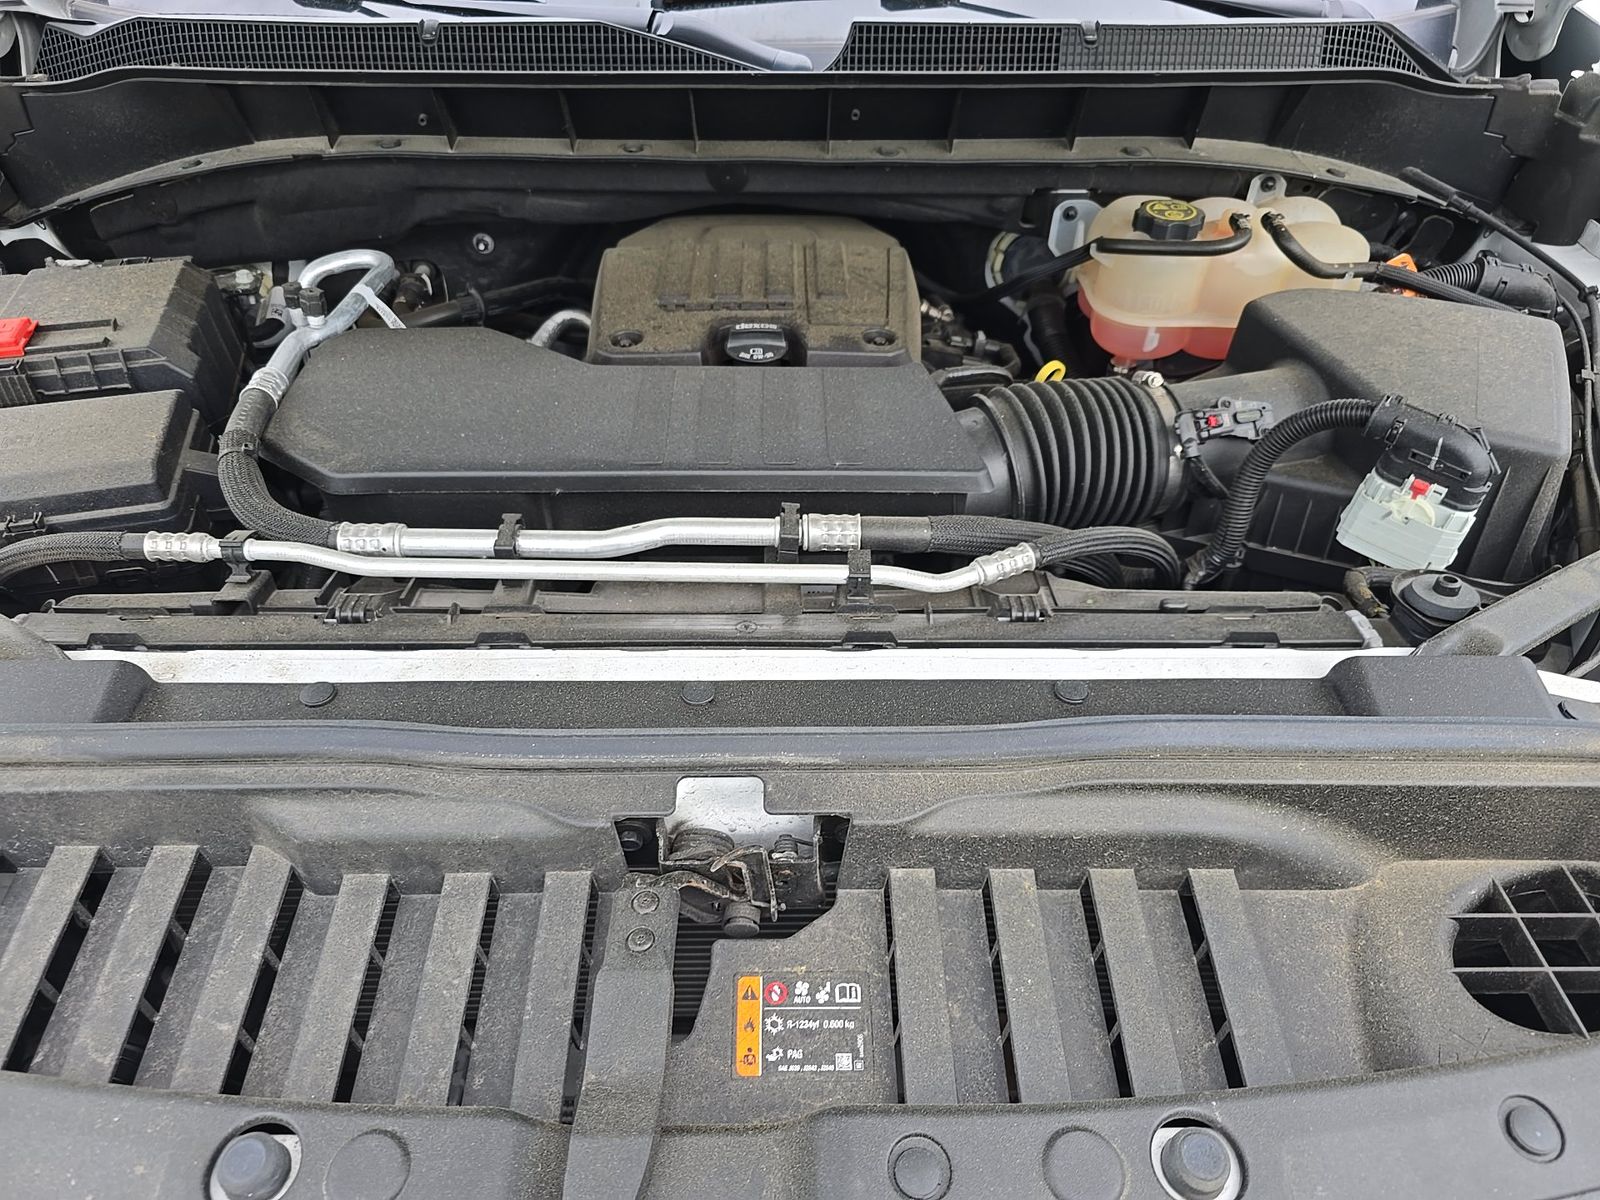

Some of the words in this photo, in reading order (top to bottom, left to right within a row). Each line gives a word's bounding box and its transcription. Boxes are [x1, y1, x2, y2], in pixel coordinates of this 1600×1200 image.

[793, 996, 811, 1004] AUTO
[845, 1019, 855, 1030] kg
[787, 1049, 803, 1060] PAG
